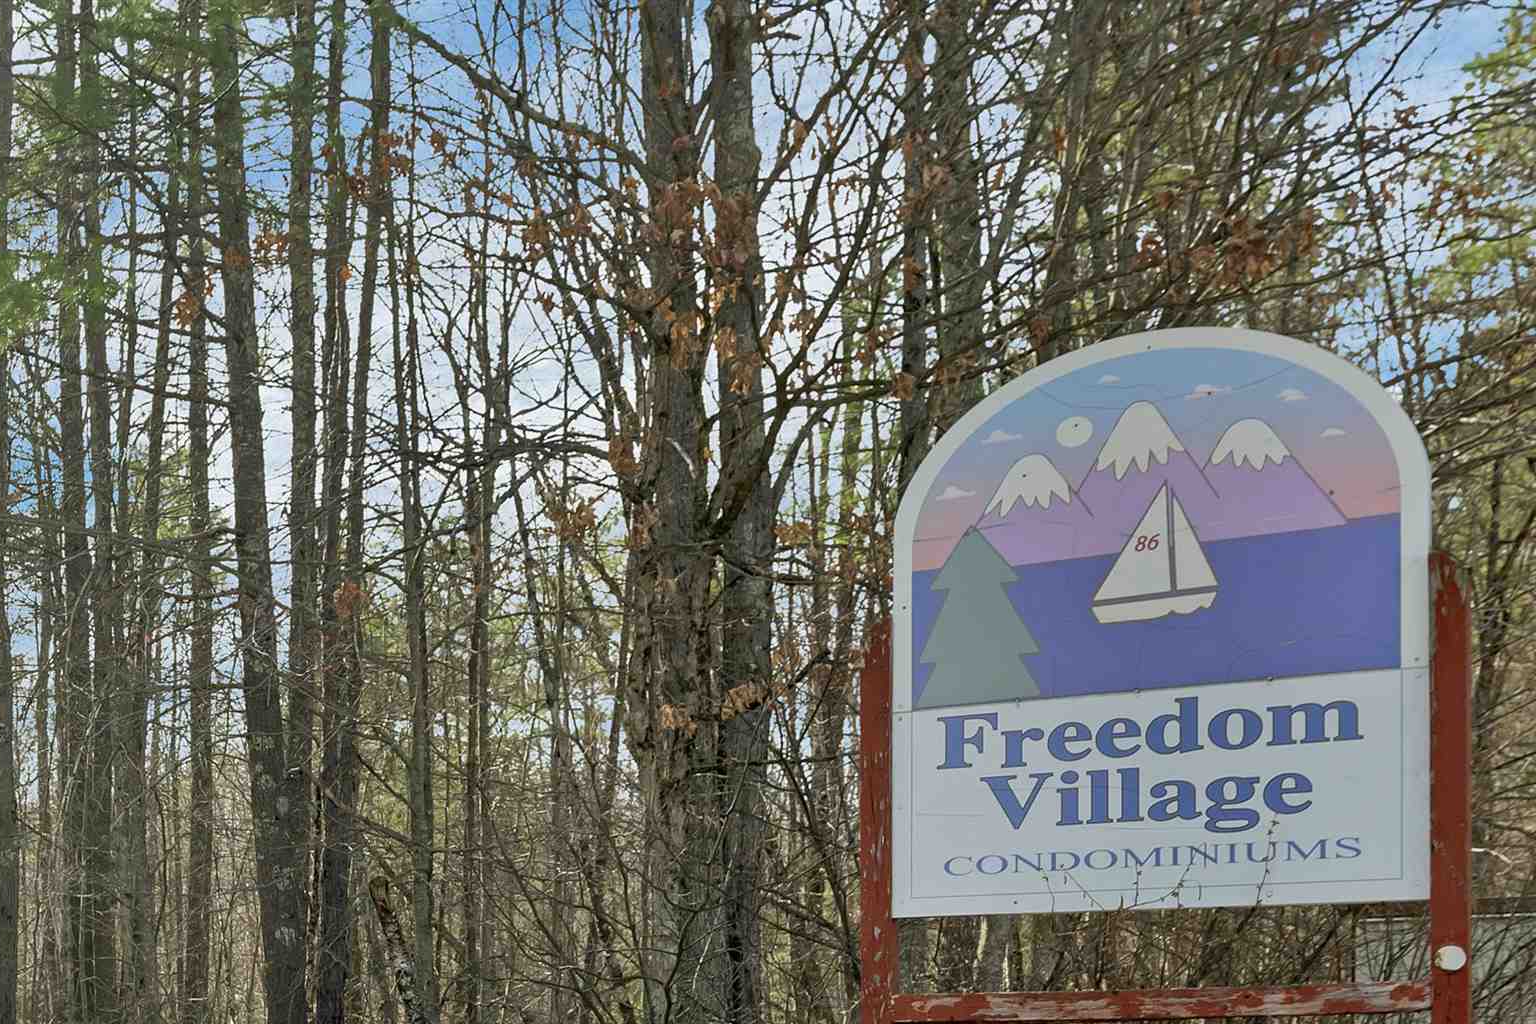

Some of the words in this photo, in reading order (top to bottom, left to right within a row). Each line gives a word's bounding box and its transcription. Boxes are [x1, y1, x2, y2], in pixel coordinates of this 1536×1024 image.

[1135, 533, 1160, 551] 86
[936, 697, 1363, 770] Freedom
[980, 767, 1313, 833] Village
[943, 836, 1362, 877] CONDOMINIUMS
